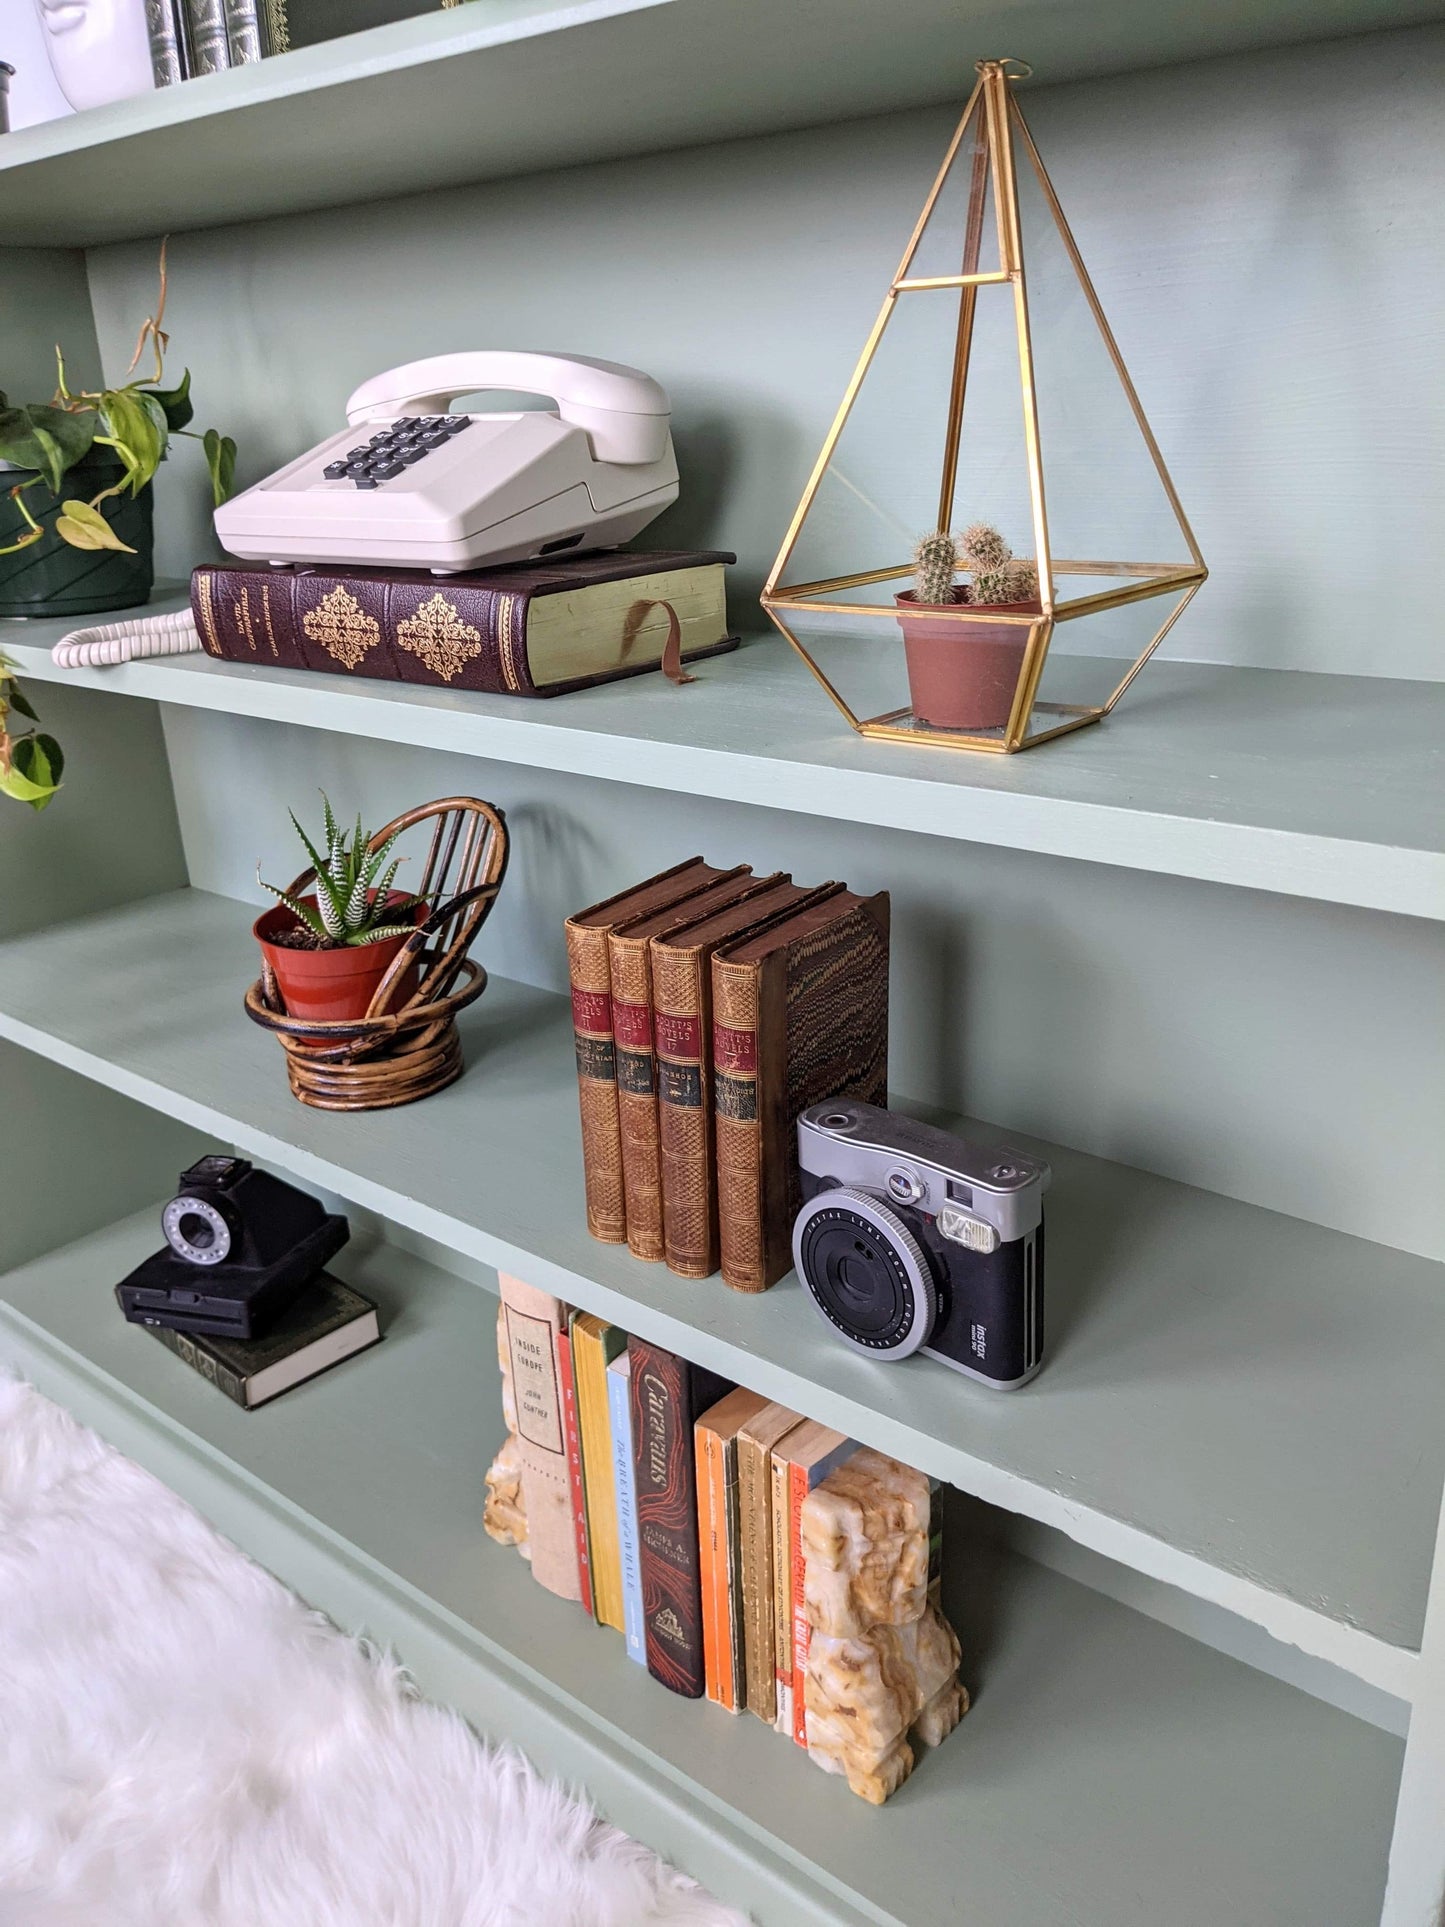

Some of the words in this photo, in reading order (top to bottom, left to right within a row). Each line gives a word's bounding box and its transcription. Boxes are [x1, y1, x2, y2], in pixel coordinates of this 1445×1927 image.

[234, 603, 245, 634] DAVID
[241, 587, 257, 651] COPPERFIELD
[262, 585, 270, 621] DICKENS
[266, 621, 279, 657] CHARLES
[656, 1014, 693, 1031] SCOTT'S
[807, 1212, 841, 1233] INSTAX
[852, 1216, 880, 1240] LENS
[895, 1303, 911, 1339] FOCUS
[515, 1337, 541, 1356] INSIDE
[971, 1341, 977, 1351] 90
[976, 1324, 987, 1360] instax
[518, 1353, 543, 1372] EUROPE
[525, 1389, 541, 1400] JOHN
[644, 1374, 668, 1487] Caravans
[618, 1459, 630, 1517] BREATH
[625, 1542, 635, 1592] WHALE
